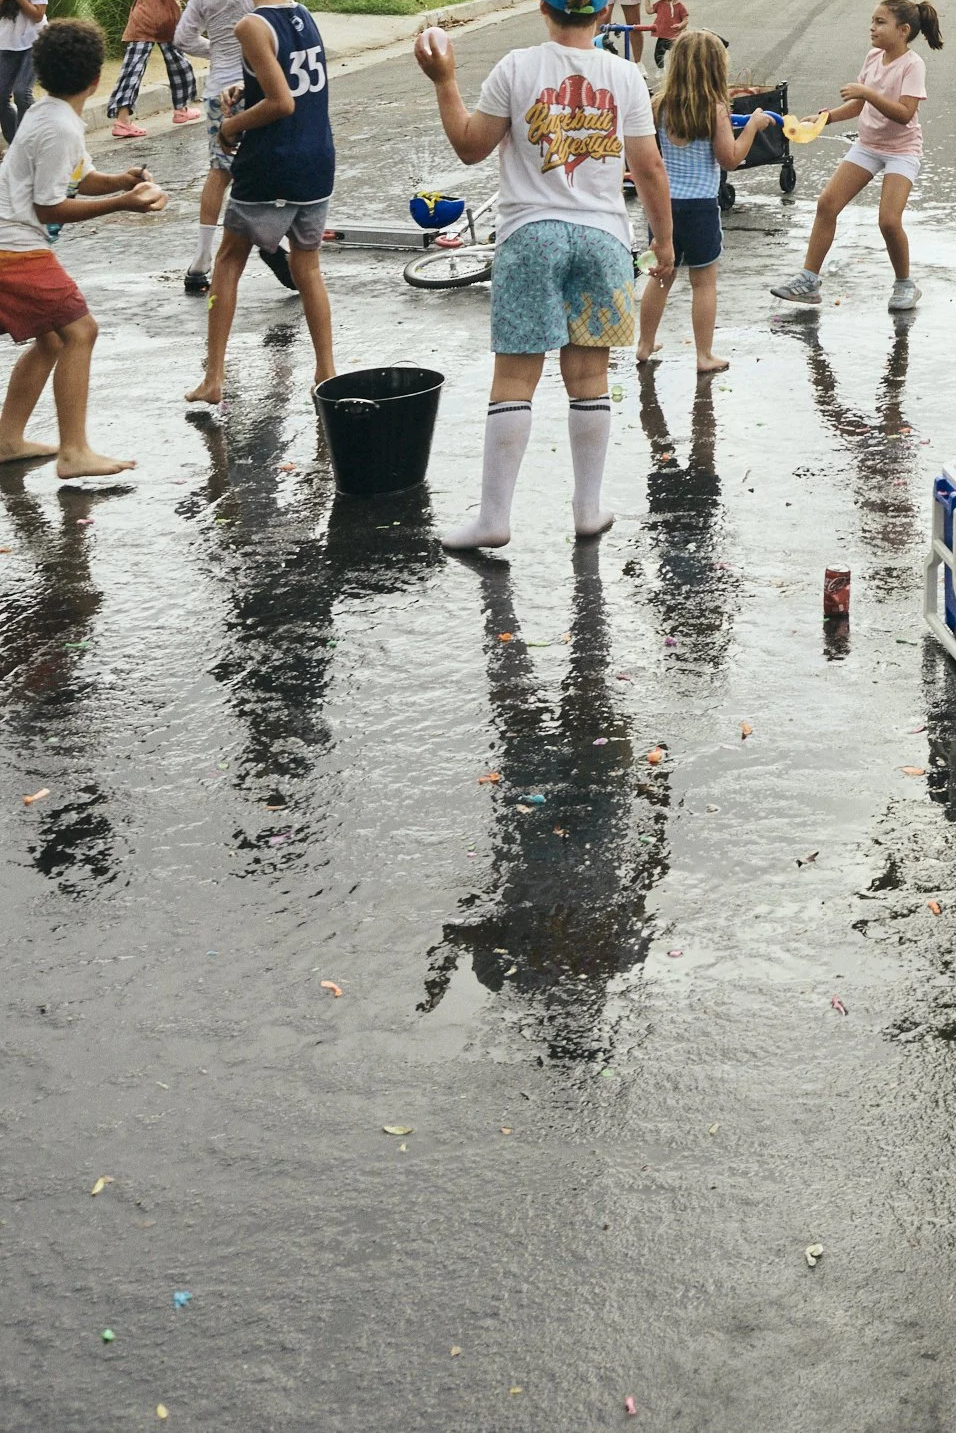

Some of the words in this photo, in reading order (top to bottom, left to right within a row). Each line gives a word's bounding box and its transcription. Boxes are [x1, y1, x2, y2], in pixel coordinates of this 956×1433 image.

[289, 45, 326, 98] 35
[524, 101, 615, 146] Baseball
[541, 127, 624, 175] Lifestyle
